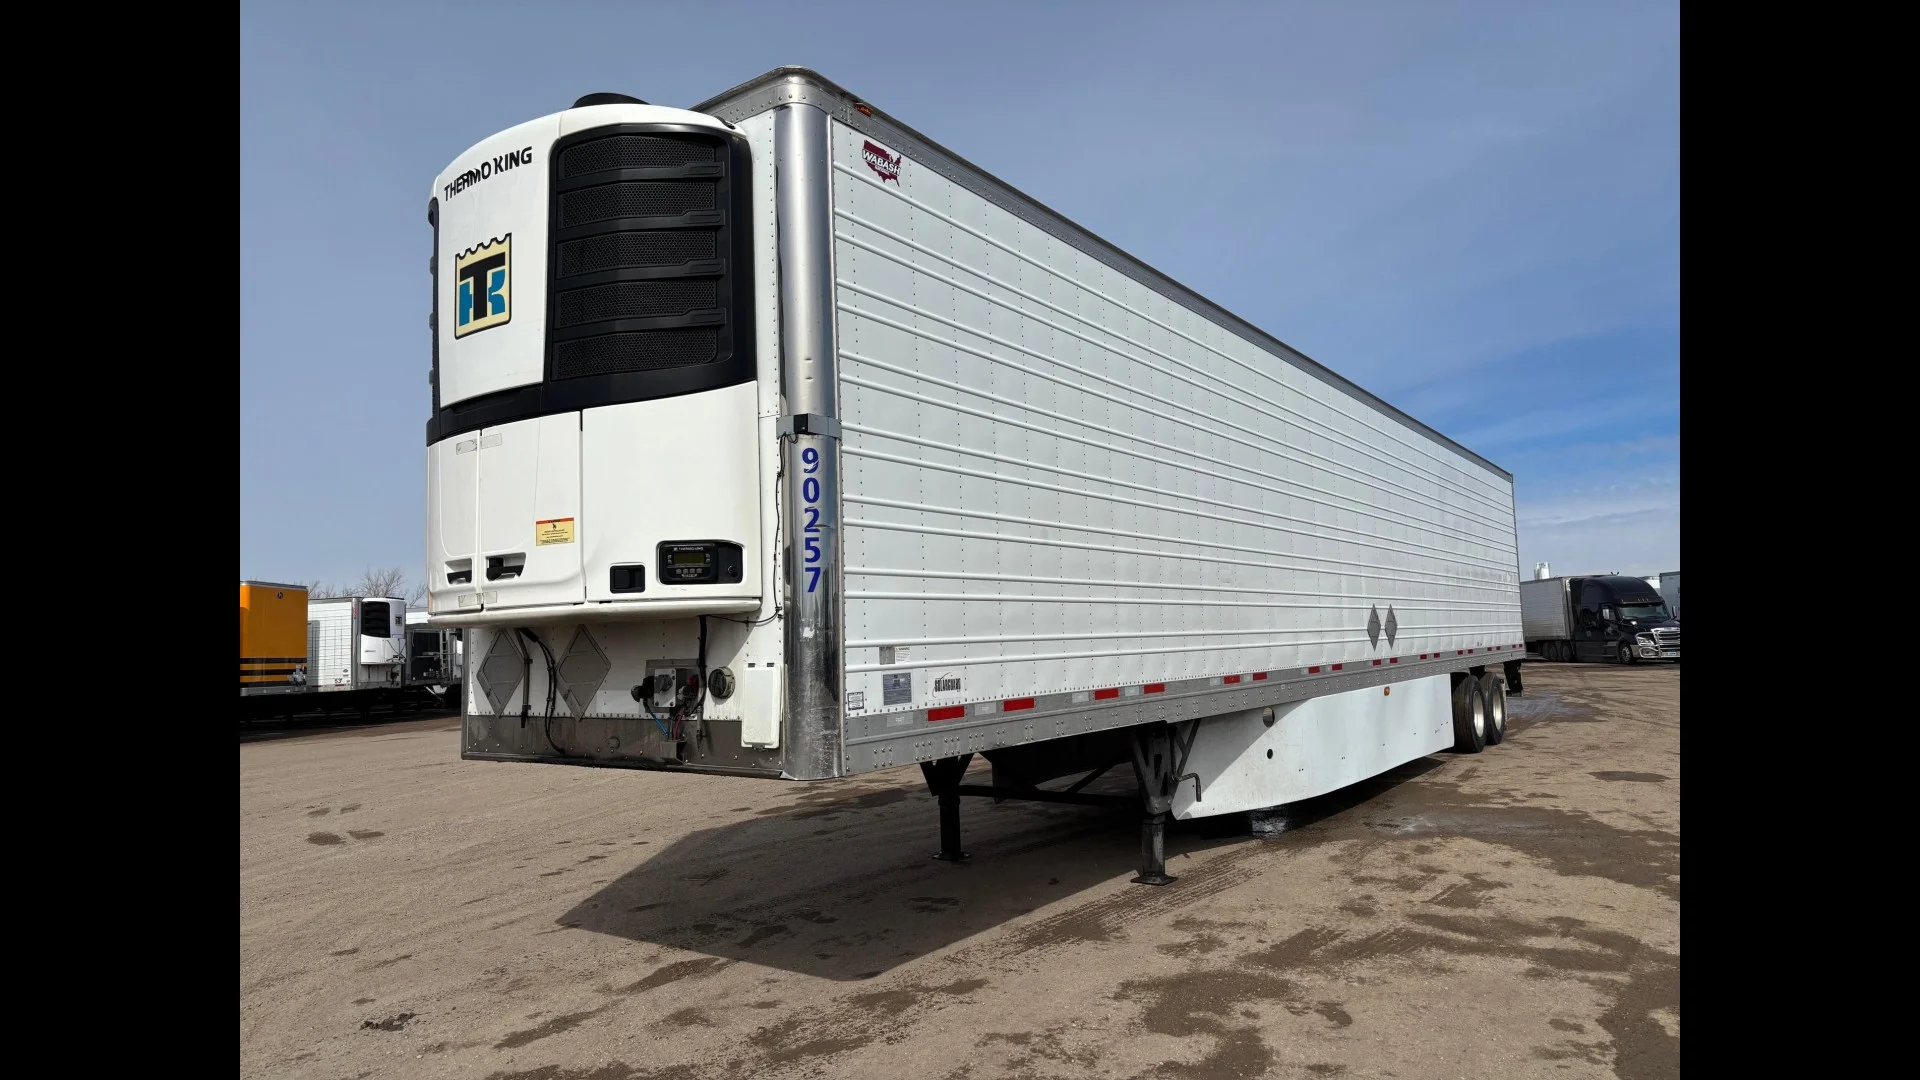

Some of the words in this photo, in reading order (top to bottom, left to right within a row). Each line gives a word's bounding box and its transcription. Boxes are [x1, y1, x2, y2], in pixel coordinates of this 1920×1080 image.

[444, 161, 492, 202] THERMO
[493, 146, 532, 175] KING
[862, 149, 901, 176] WABASH
[801, 447, 821, 593] 90257
